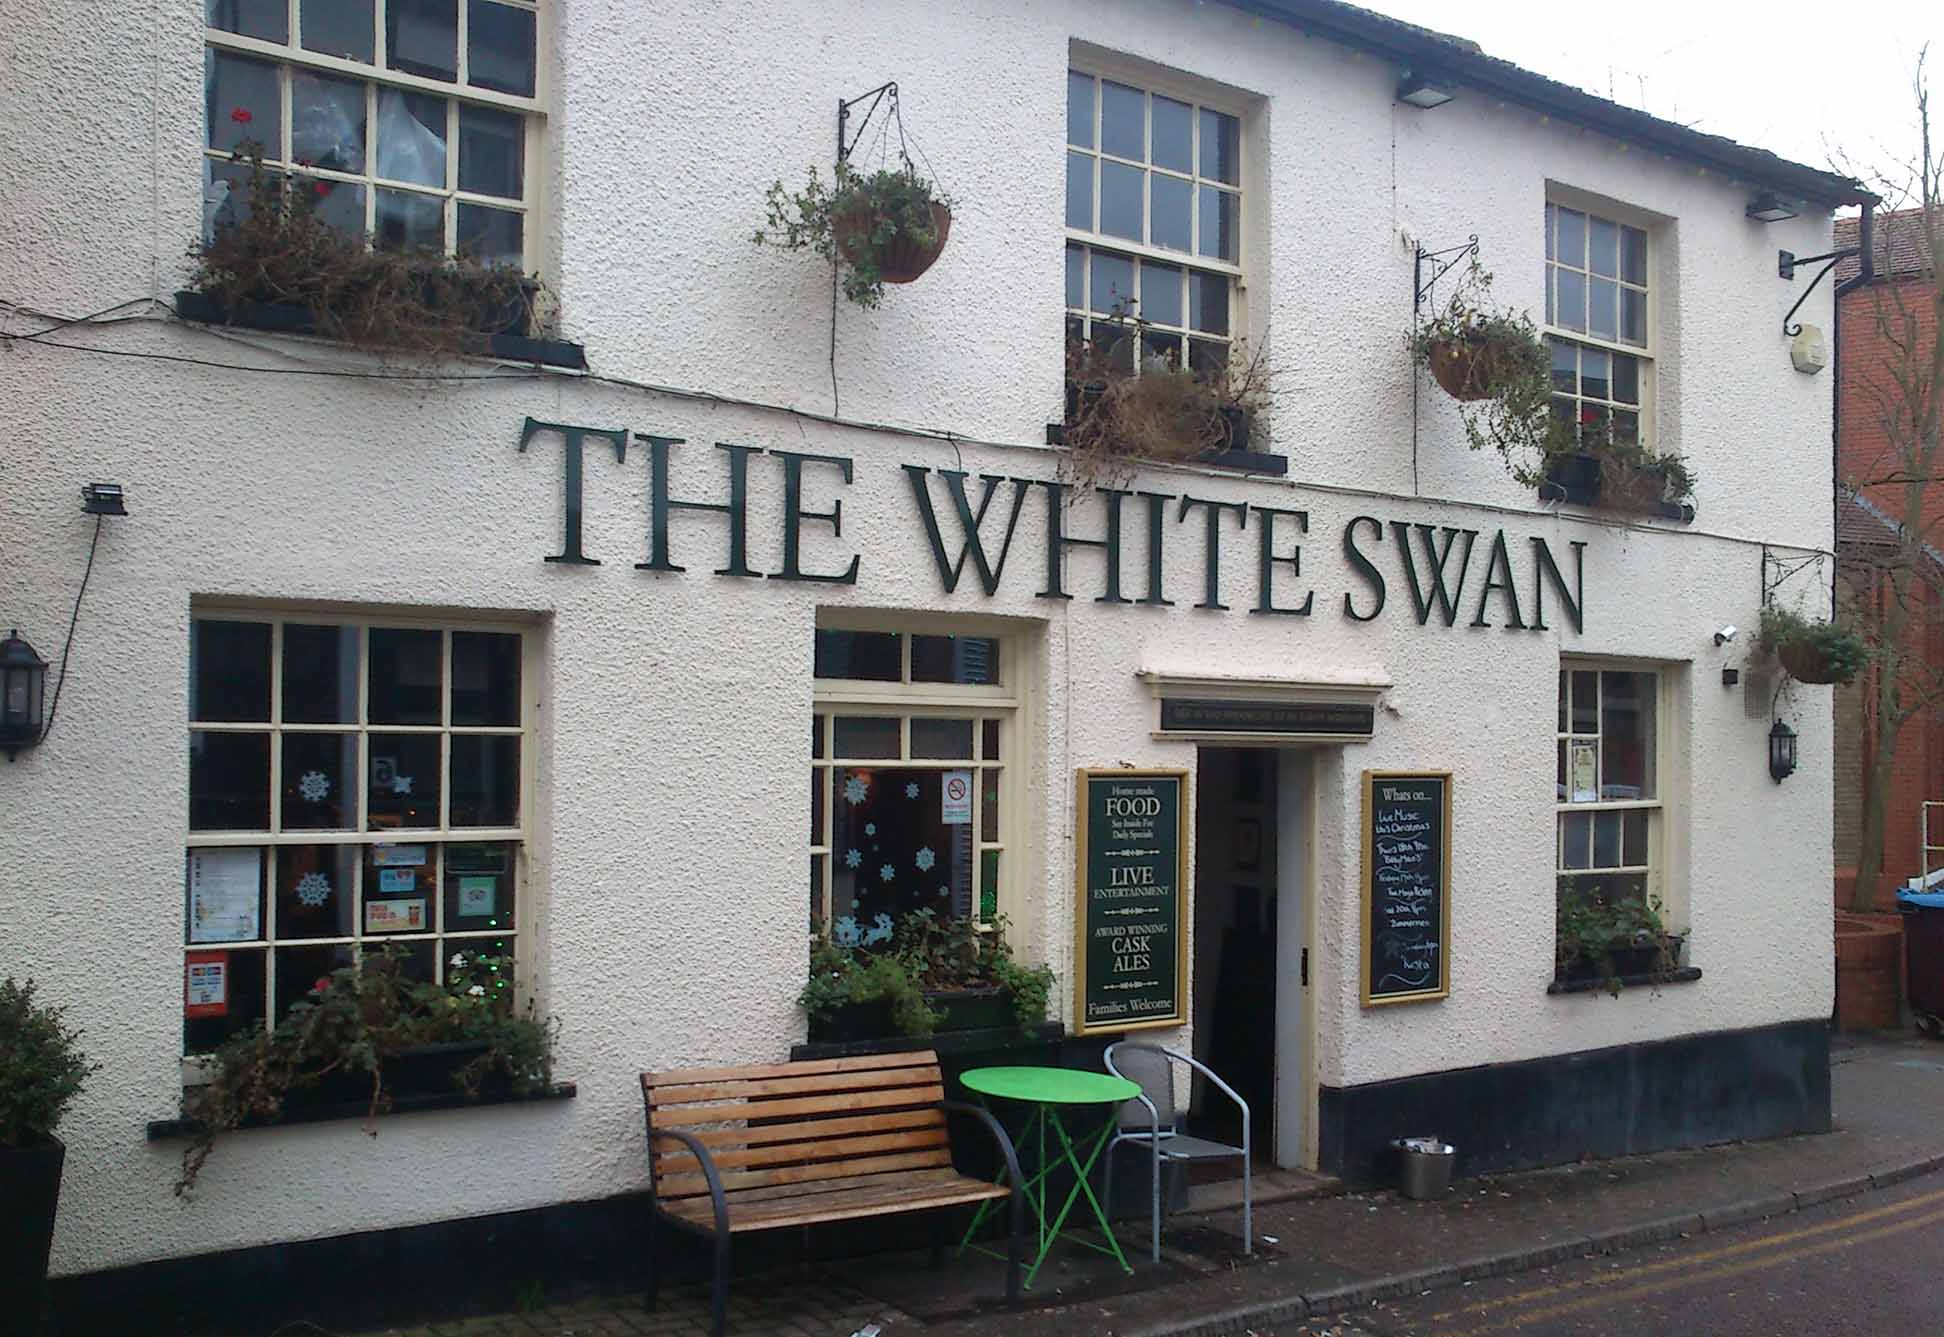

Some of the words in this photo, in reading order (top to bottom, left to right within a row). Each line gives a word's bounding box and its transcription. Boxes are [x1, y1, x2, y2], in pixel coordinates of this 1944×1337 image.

[518, 416, 860, 585] THE
[901, 463, 1314, 617] WHITE
[1344, 515, 1588, 634] SWAN
[1105, 797, 1161, 817] FOOD
[1110, 866, 1154, 886] LIVE
[1094, 886, 1169, 899] ENTERTAINMENT
[1095, 926, 1126, 937] AWARD
[1128, 923, 1168, 936] WINNING
[1111, 935, 1151, 954] CASK
[1112, 953, 1151, 973] ALES
[1088, 1001, 1128, 1016] Families
[1129, 999, 1174, 1012] Welcome
